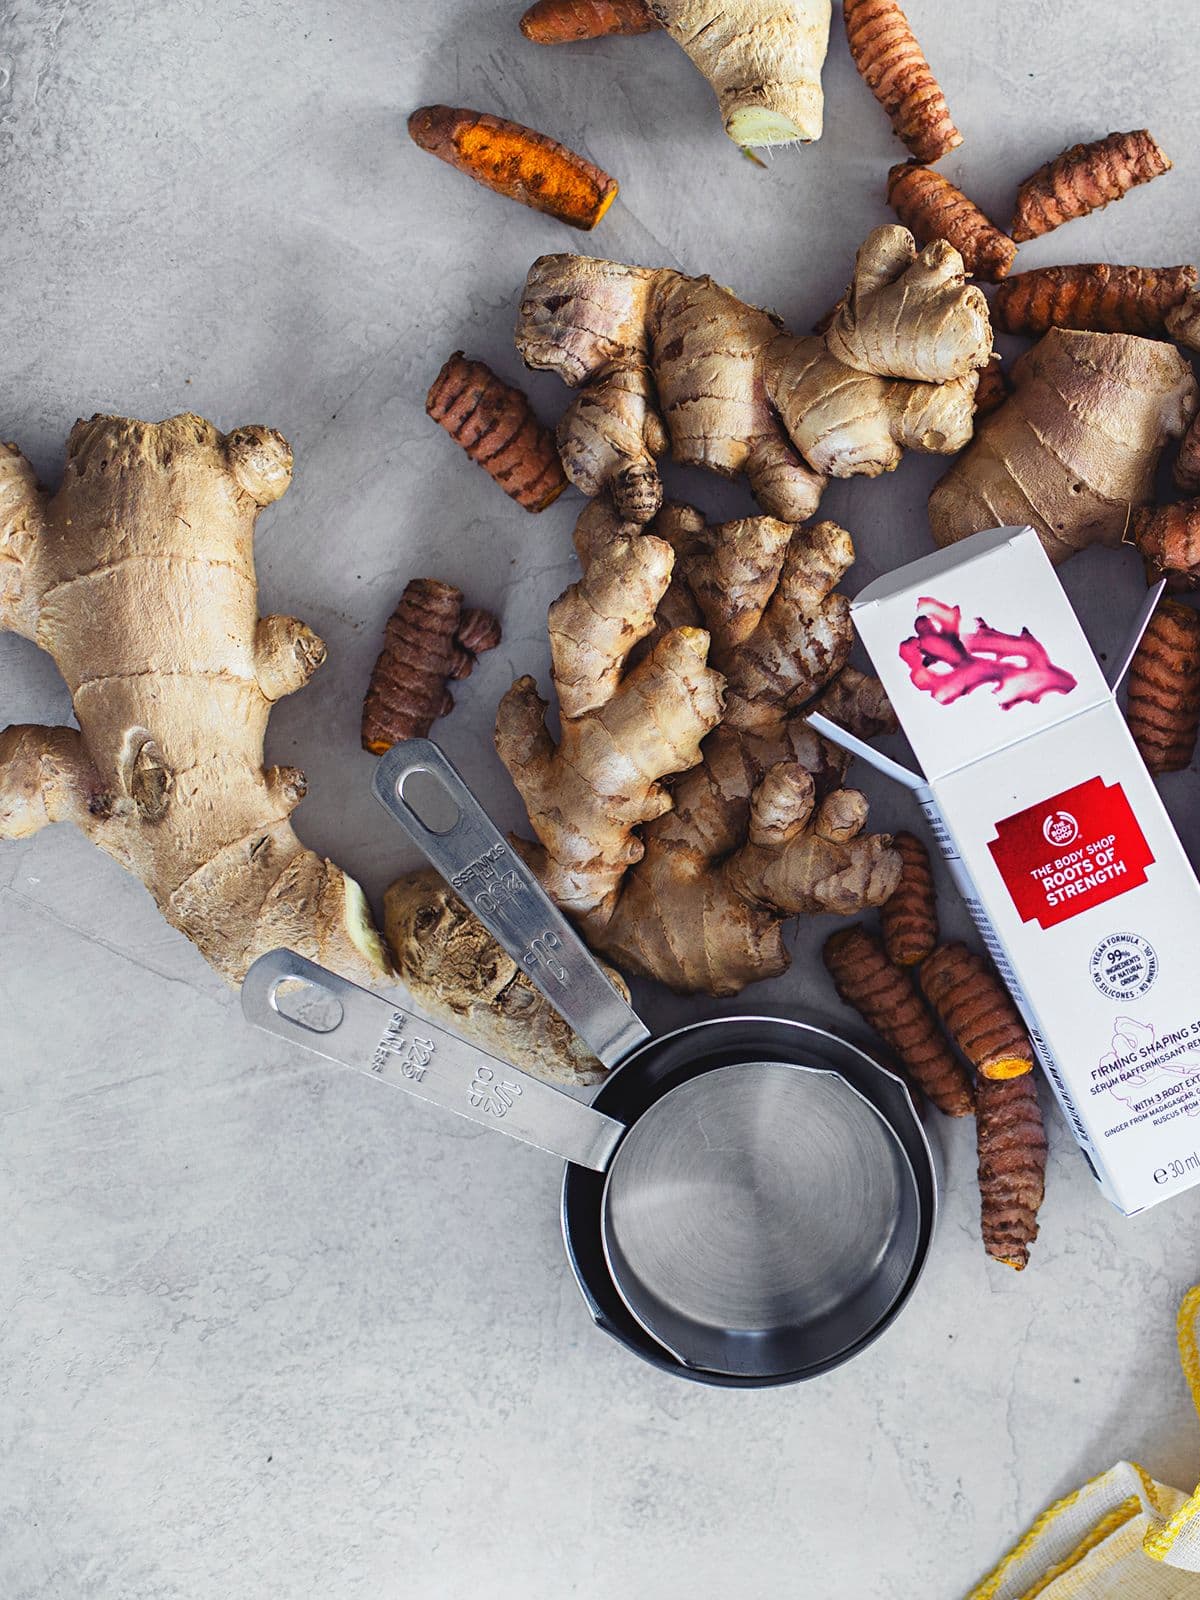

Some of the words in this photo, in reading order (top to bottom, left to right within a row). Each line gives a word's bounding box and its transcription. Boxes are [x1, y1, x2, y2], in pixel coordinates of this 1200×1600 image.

[1051, 824, 1071, 837] BODY
[1053, 821, 1065, 830] THE
[1055, 830, 1073, 842] SHOP
[450, 843, 506, 889] STAINLESS
[1030, 864, 1054, 880] THE
[1054, 849, 1083, 869] BODY
[1086, 835, 1115, 854] SHOP
[1042, 859, 1094, 891] ROOTS
[1096, 847, 1114, 866] OF
[475, 869, 523, 915] 250
[1046, 860, 1127, 906] STRENGTH
[523, 930, 559, 966] CUP
[1093, 943, 1107, 966] VEGAN
[1107, 935, 1139, 945] FORMULA
[546, 958, 566, 980] 1
[1105, 955, 1141, 975] INGREDIENTS
[1109, 974, 1117, 982] OF
[1118, 963, 1144, 979] NATURAL
[1120, 974, 1140, 986] ORIGIN
[1093, 972, 1102, 983] NO
[1099, 982, 1135, 998] SILICONES
[1139, 982, 1149, 992] NO
[371, 1011, 407, 1073] STAINLESS
[1091, 1052, 1138, 1080] FIRMING
[1139, 1028, 1189, 1058] SHAPING
[401, 1036, 436, 1082] 125
[1090, 1078, 1119, 1096] SÉRUM
[1120, 1046, 1187, 1082] RAFFERMISSANT
[467, 1065, 494, 1107] CUP
[483, 1081, 523, 1118] 1/2
[1133, 1098, 1155, 1113] WITH
[1156, 1094, 1163, 1103] 3
[1162, 1083, 1184, 1100] ROOT
[1104, 1121, 1129, 1138] GINGER
[1129, 1113, 1149, 1126] FROM
[1150, 1091, 1196, 1117] MADAGASCAR,
[1152, 1111, 1180, 1127] RUSCUS
[1181, 1100, 1199, 1113] FROM
[1168, 1159, 1185, 1178] 30
[1185, 1151, 1200, 1171] ml
